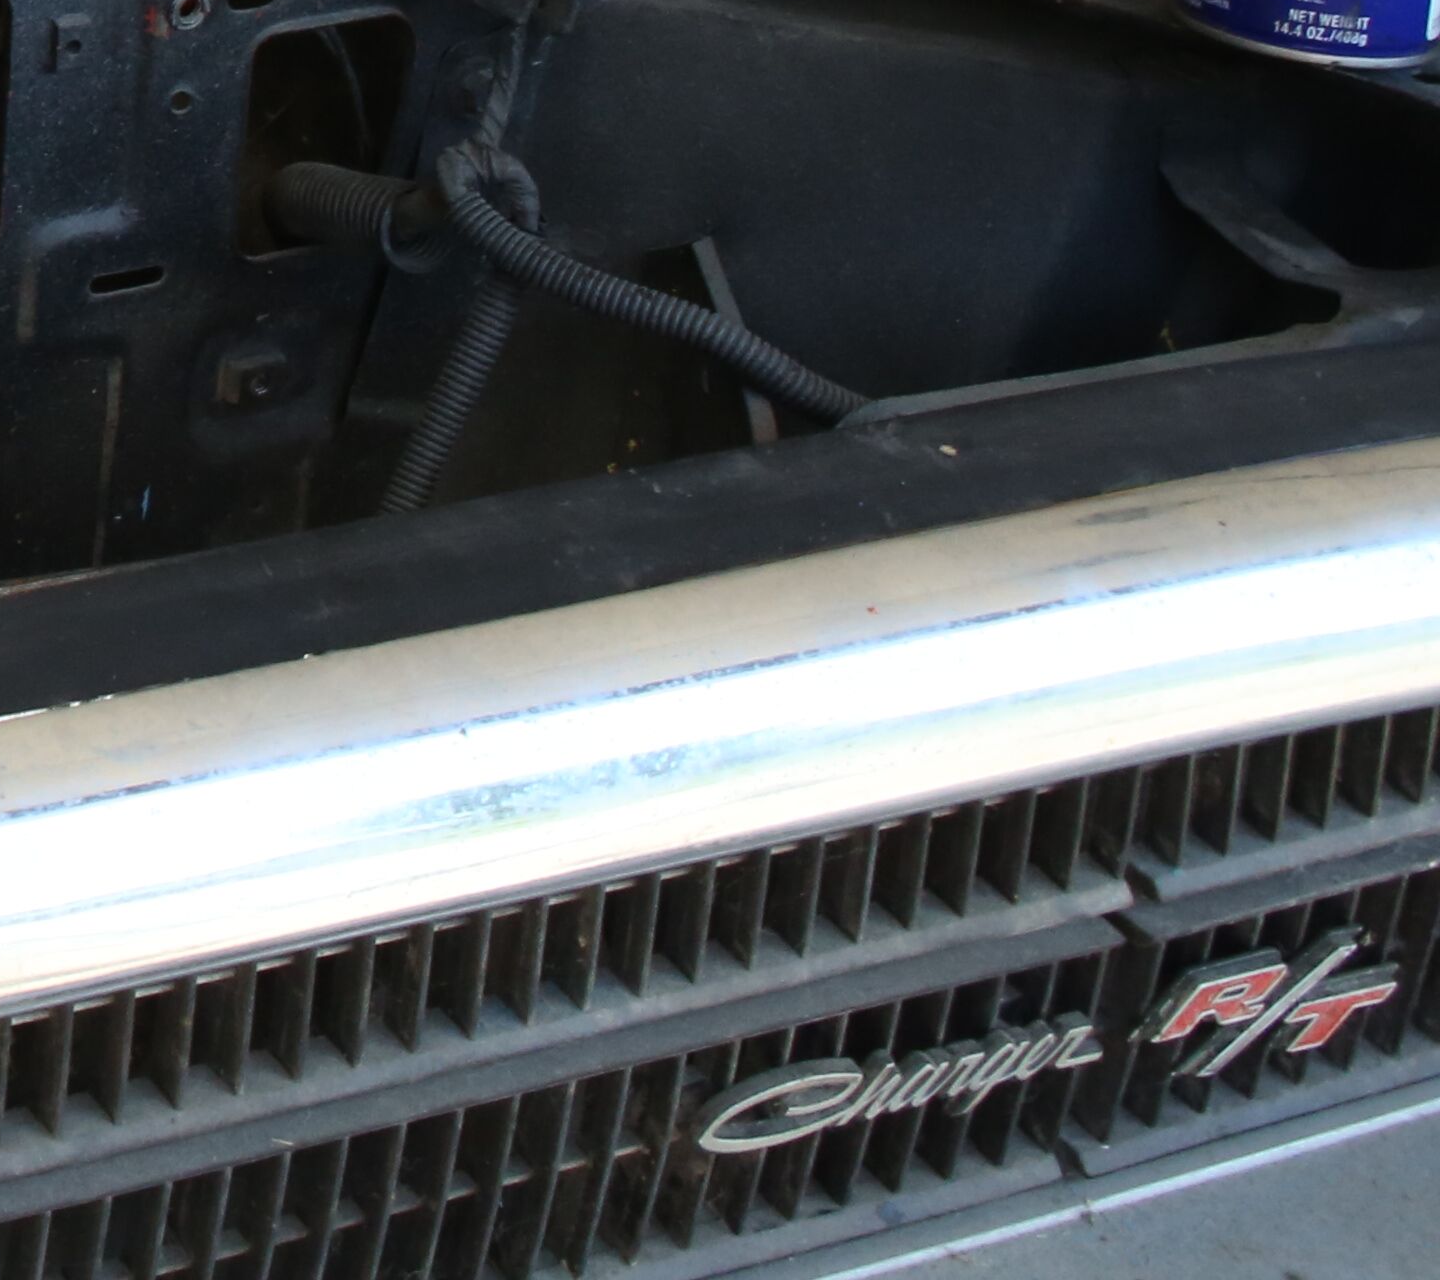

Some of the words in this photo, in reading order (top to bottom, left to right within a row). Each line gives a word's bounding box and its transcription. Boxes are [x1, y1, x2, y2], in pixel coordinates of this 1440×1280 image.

[1288, 8, 1317, 25] NET
[1274, 20, 1302, 37] 14.4
[699, 1023, 1103, 1153] Charger
[1151, 940, 1398, 1078] R/T
